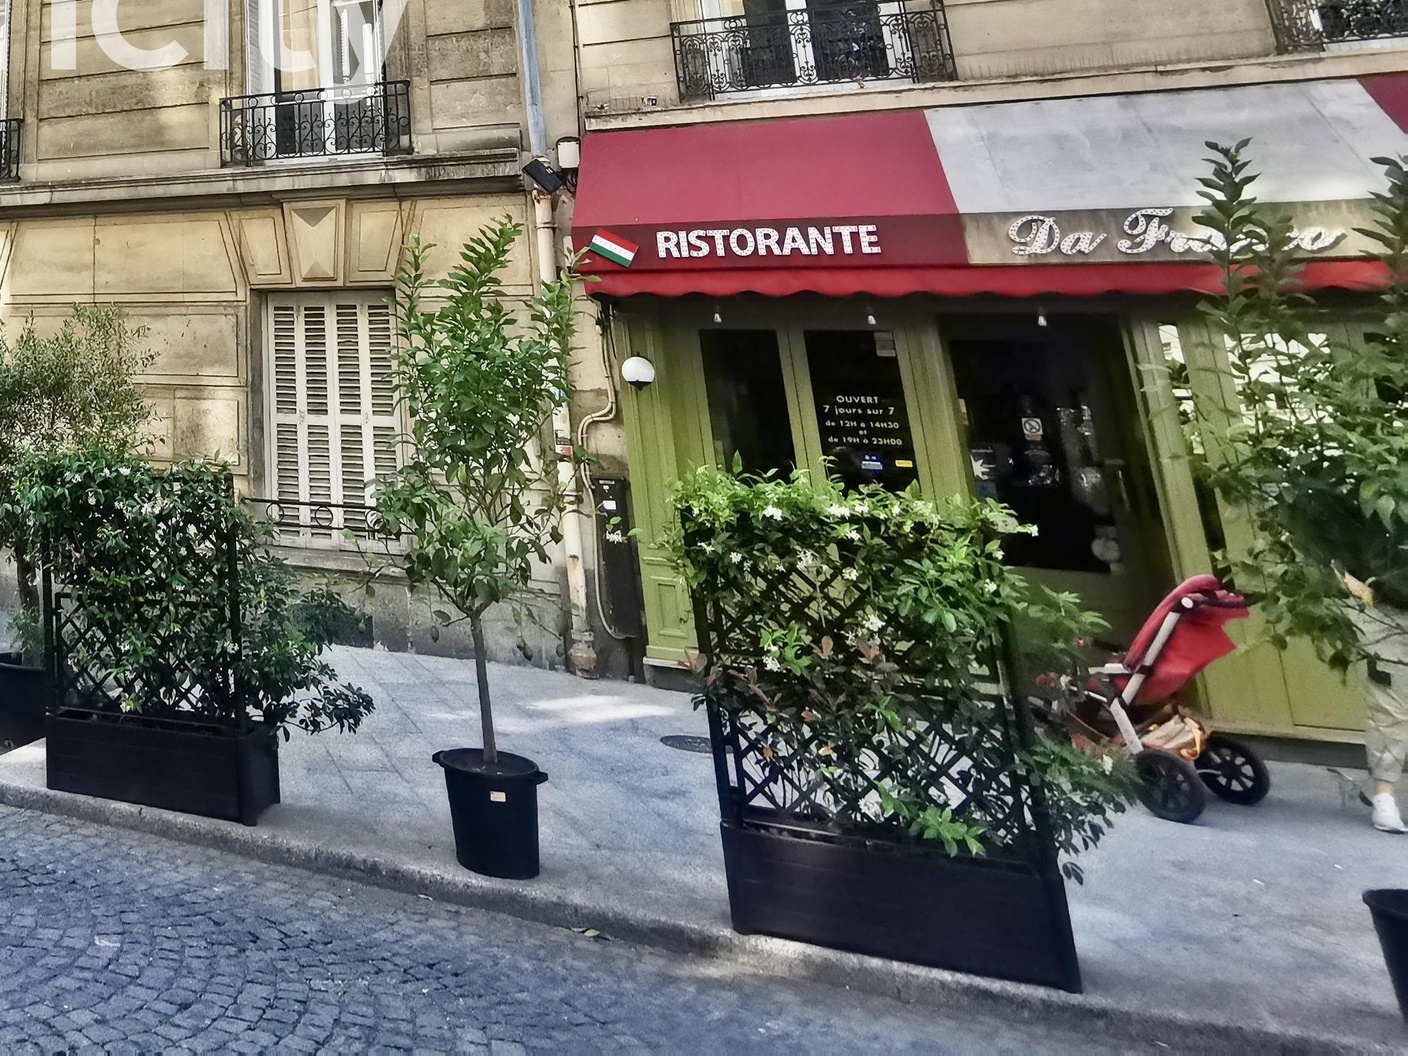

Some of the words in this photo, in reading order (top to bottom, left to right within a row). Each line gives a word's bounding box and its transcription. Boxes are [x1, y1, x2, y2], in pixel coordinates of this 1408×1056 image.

[1008, 214, 1108, 255] Da
[656, 224, 882, 258] RISTORANTE
[836, 395, 878, 404] OUVERT
[823, 405, 830, 413] 7
[834, 405, 862, 415] jours
[888, 407, 895, 415] 7
[870, 421, 899, 429] 14H30
